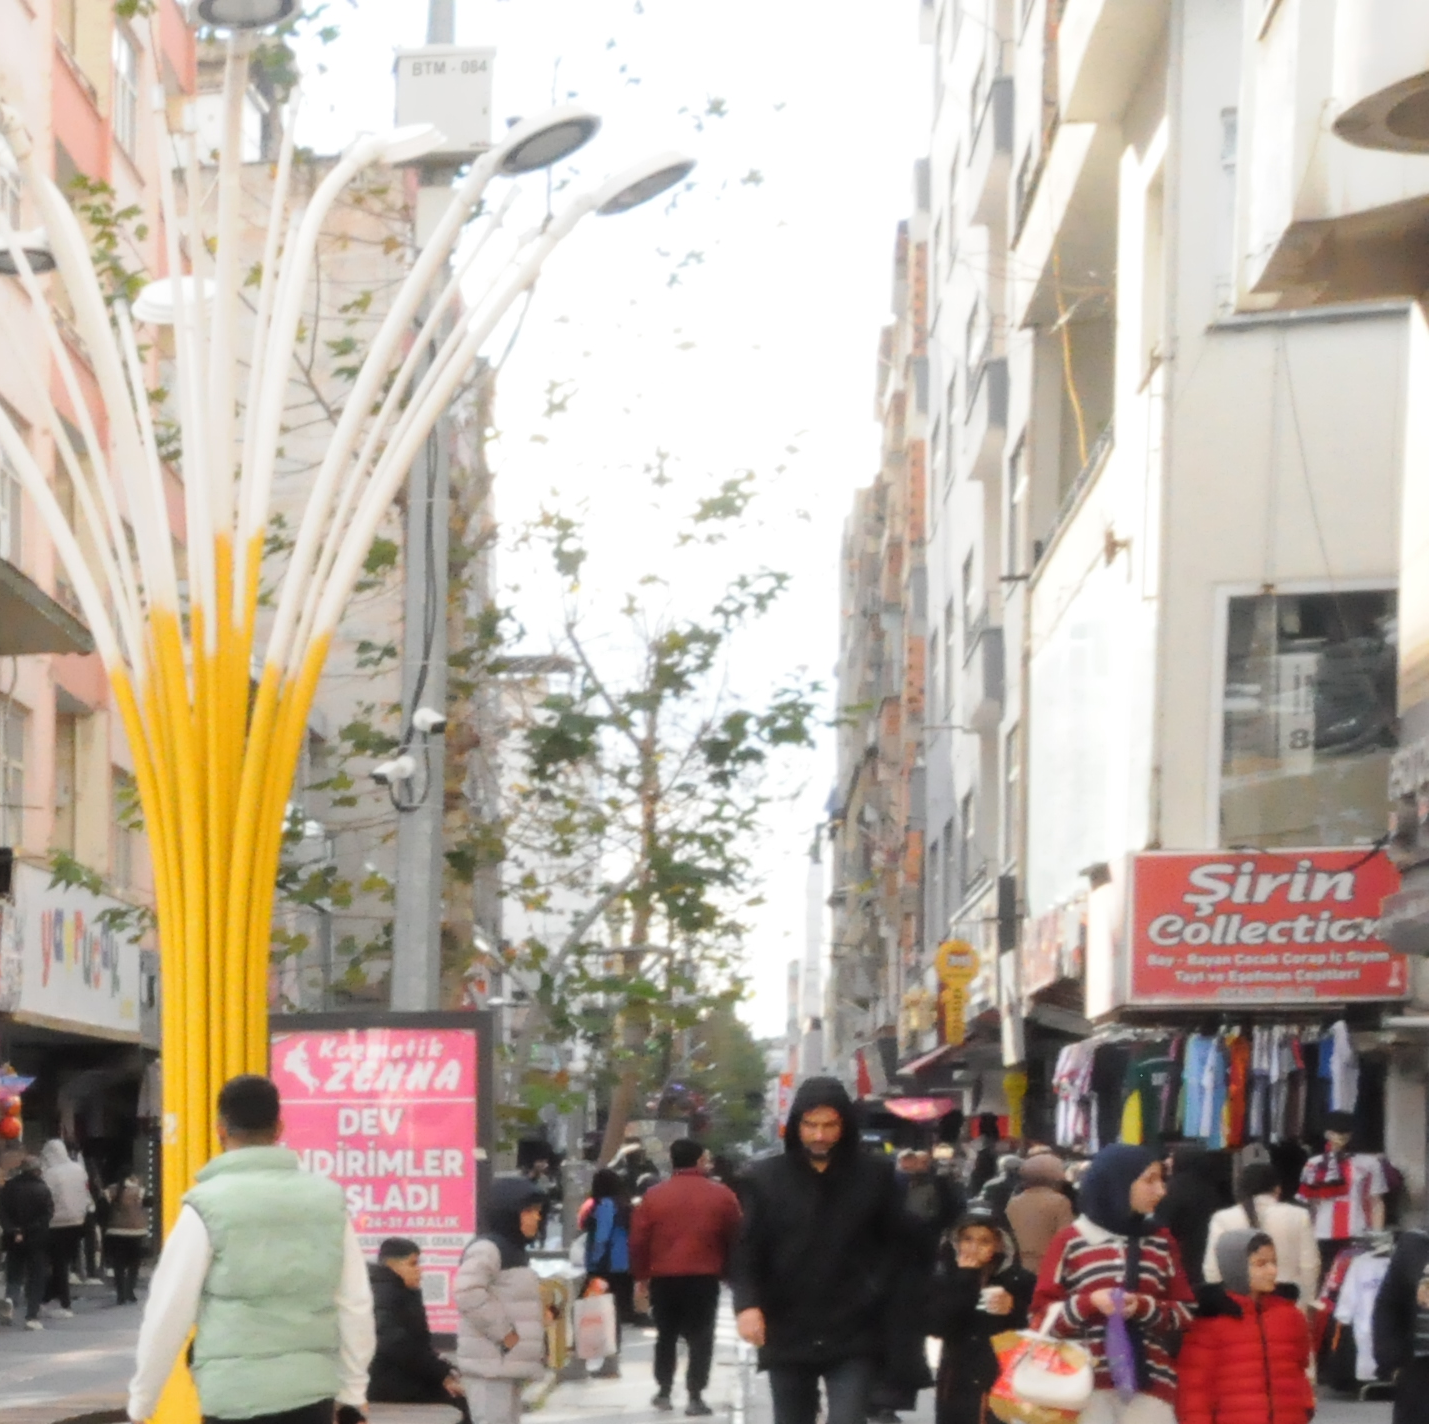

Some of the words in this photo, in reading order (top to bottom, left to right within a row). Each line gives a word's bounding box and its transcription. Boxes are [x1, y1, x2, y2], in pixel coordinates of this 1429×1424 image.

[412, 61, 446, 76] BTM
[1182, 859, 1356, 917] Şirin
[318, 1036, 443, 1060] Kozmetik
[324, 1058, 461, 1092] ZENNA
[338, 1107, 404, 1136] DEV
[278, 1141, 464, 1178] NDİRİMLER
[405, 1215, 460, 1229] ARALIK
